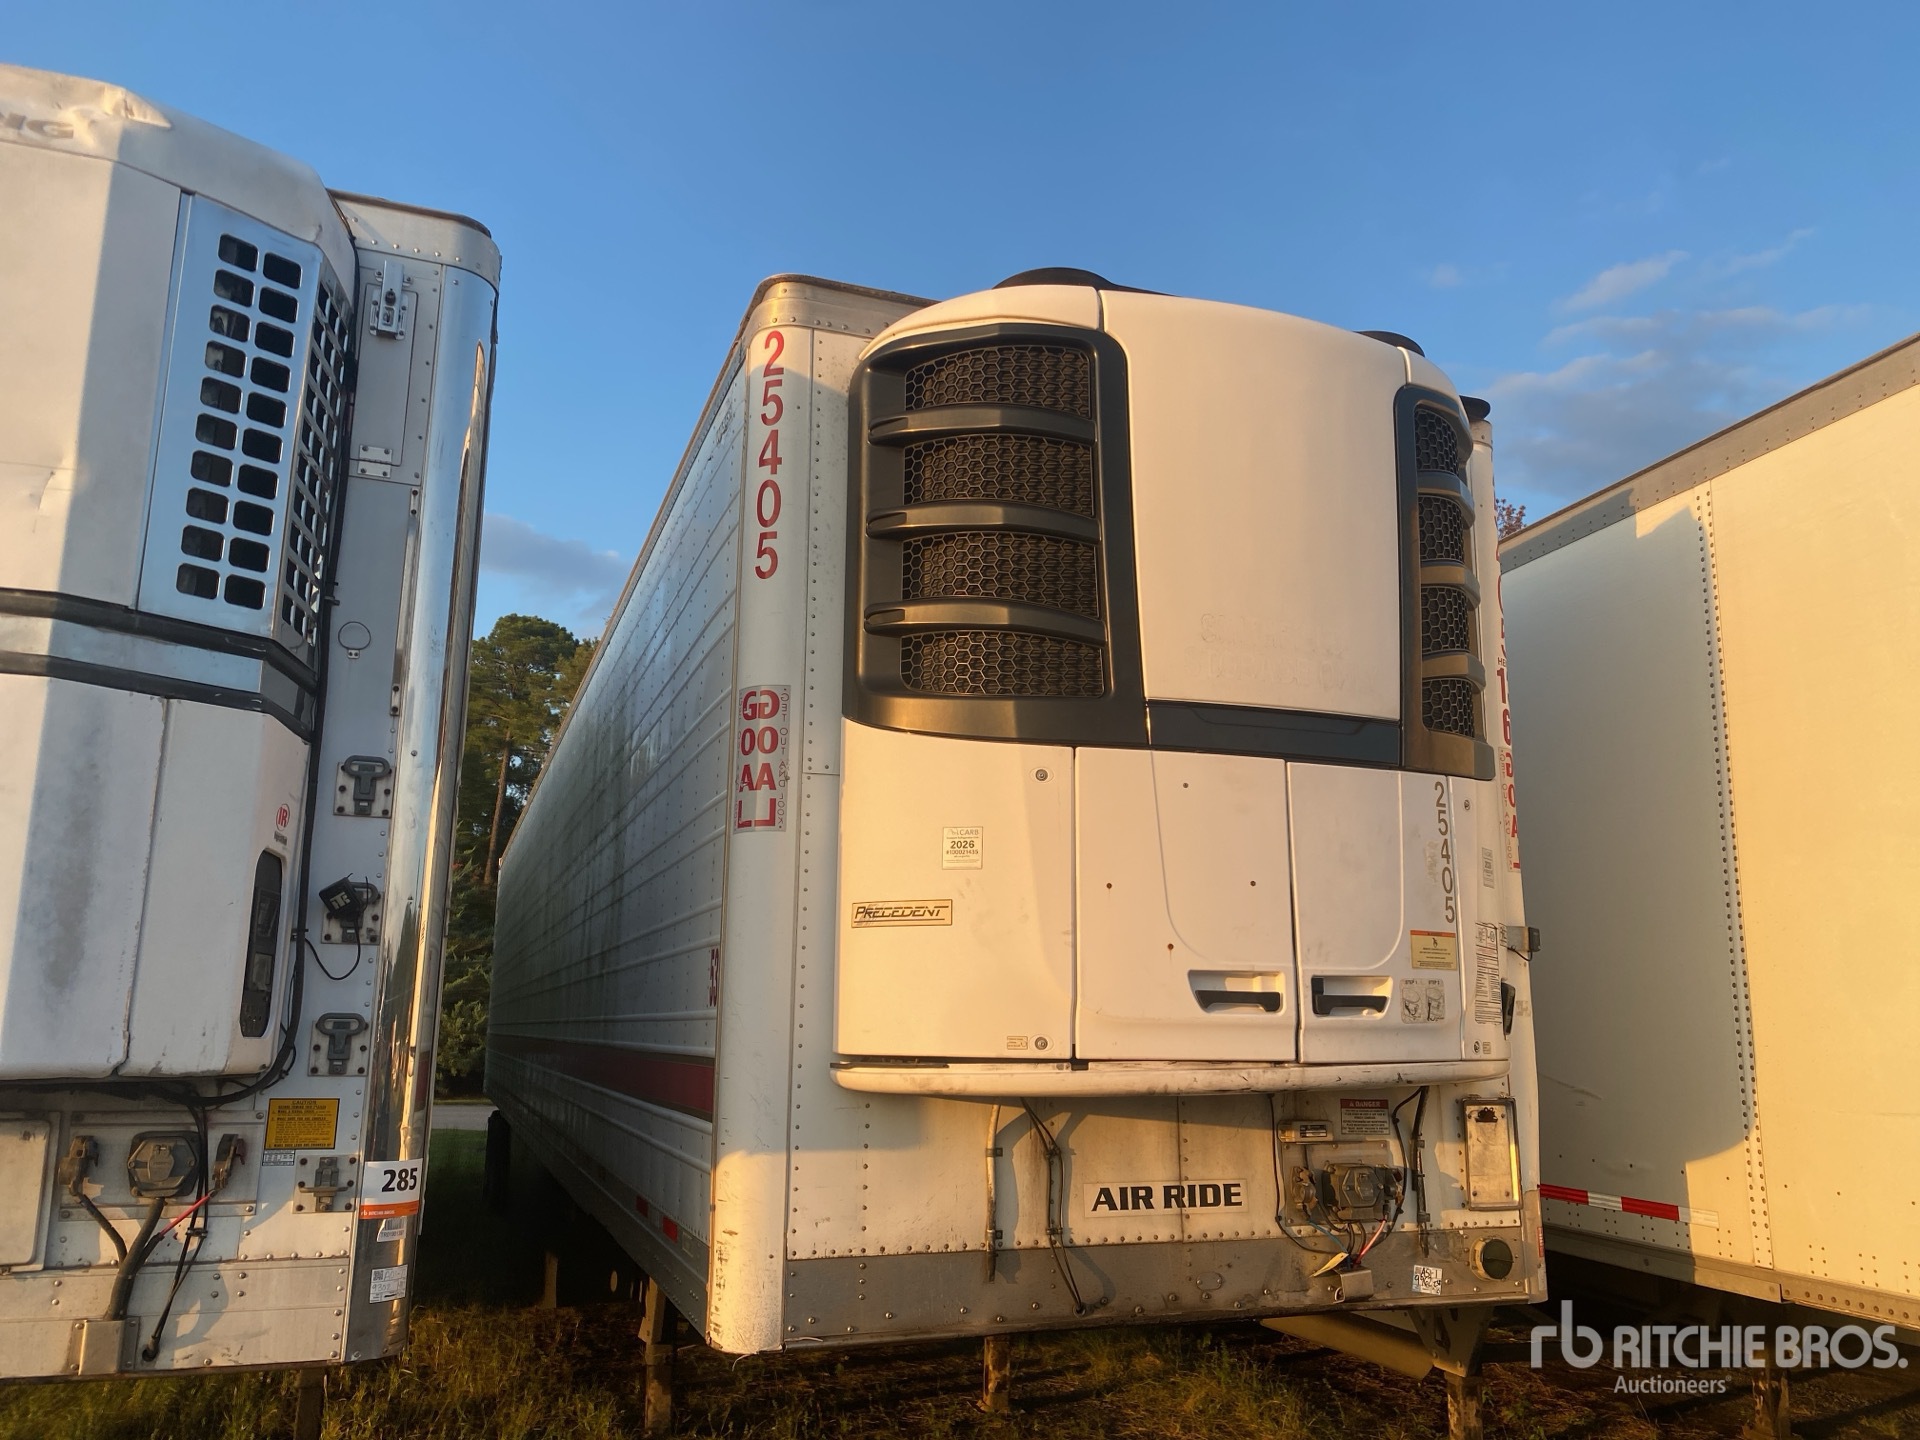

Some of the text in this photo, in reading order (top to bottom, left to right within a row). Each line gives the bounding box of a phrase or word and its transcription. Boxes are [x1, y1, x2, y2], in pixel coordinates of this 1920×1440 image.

[754, 330, 785, 580] 25405
[950, 840, 975, 849] 2026
[1434, 781, 1455, 924] 25405
[855, 905, 949, 919] PRECEDENT
[382, 1168, 418, 1192] 285
[1091, 1182, 1243, 1212] AIR RIDE
